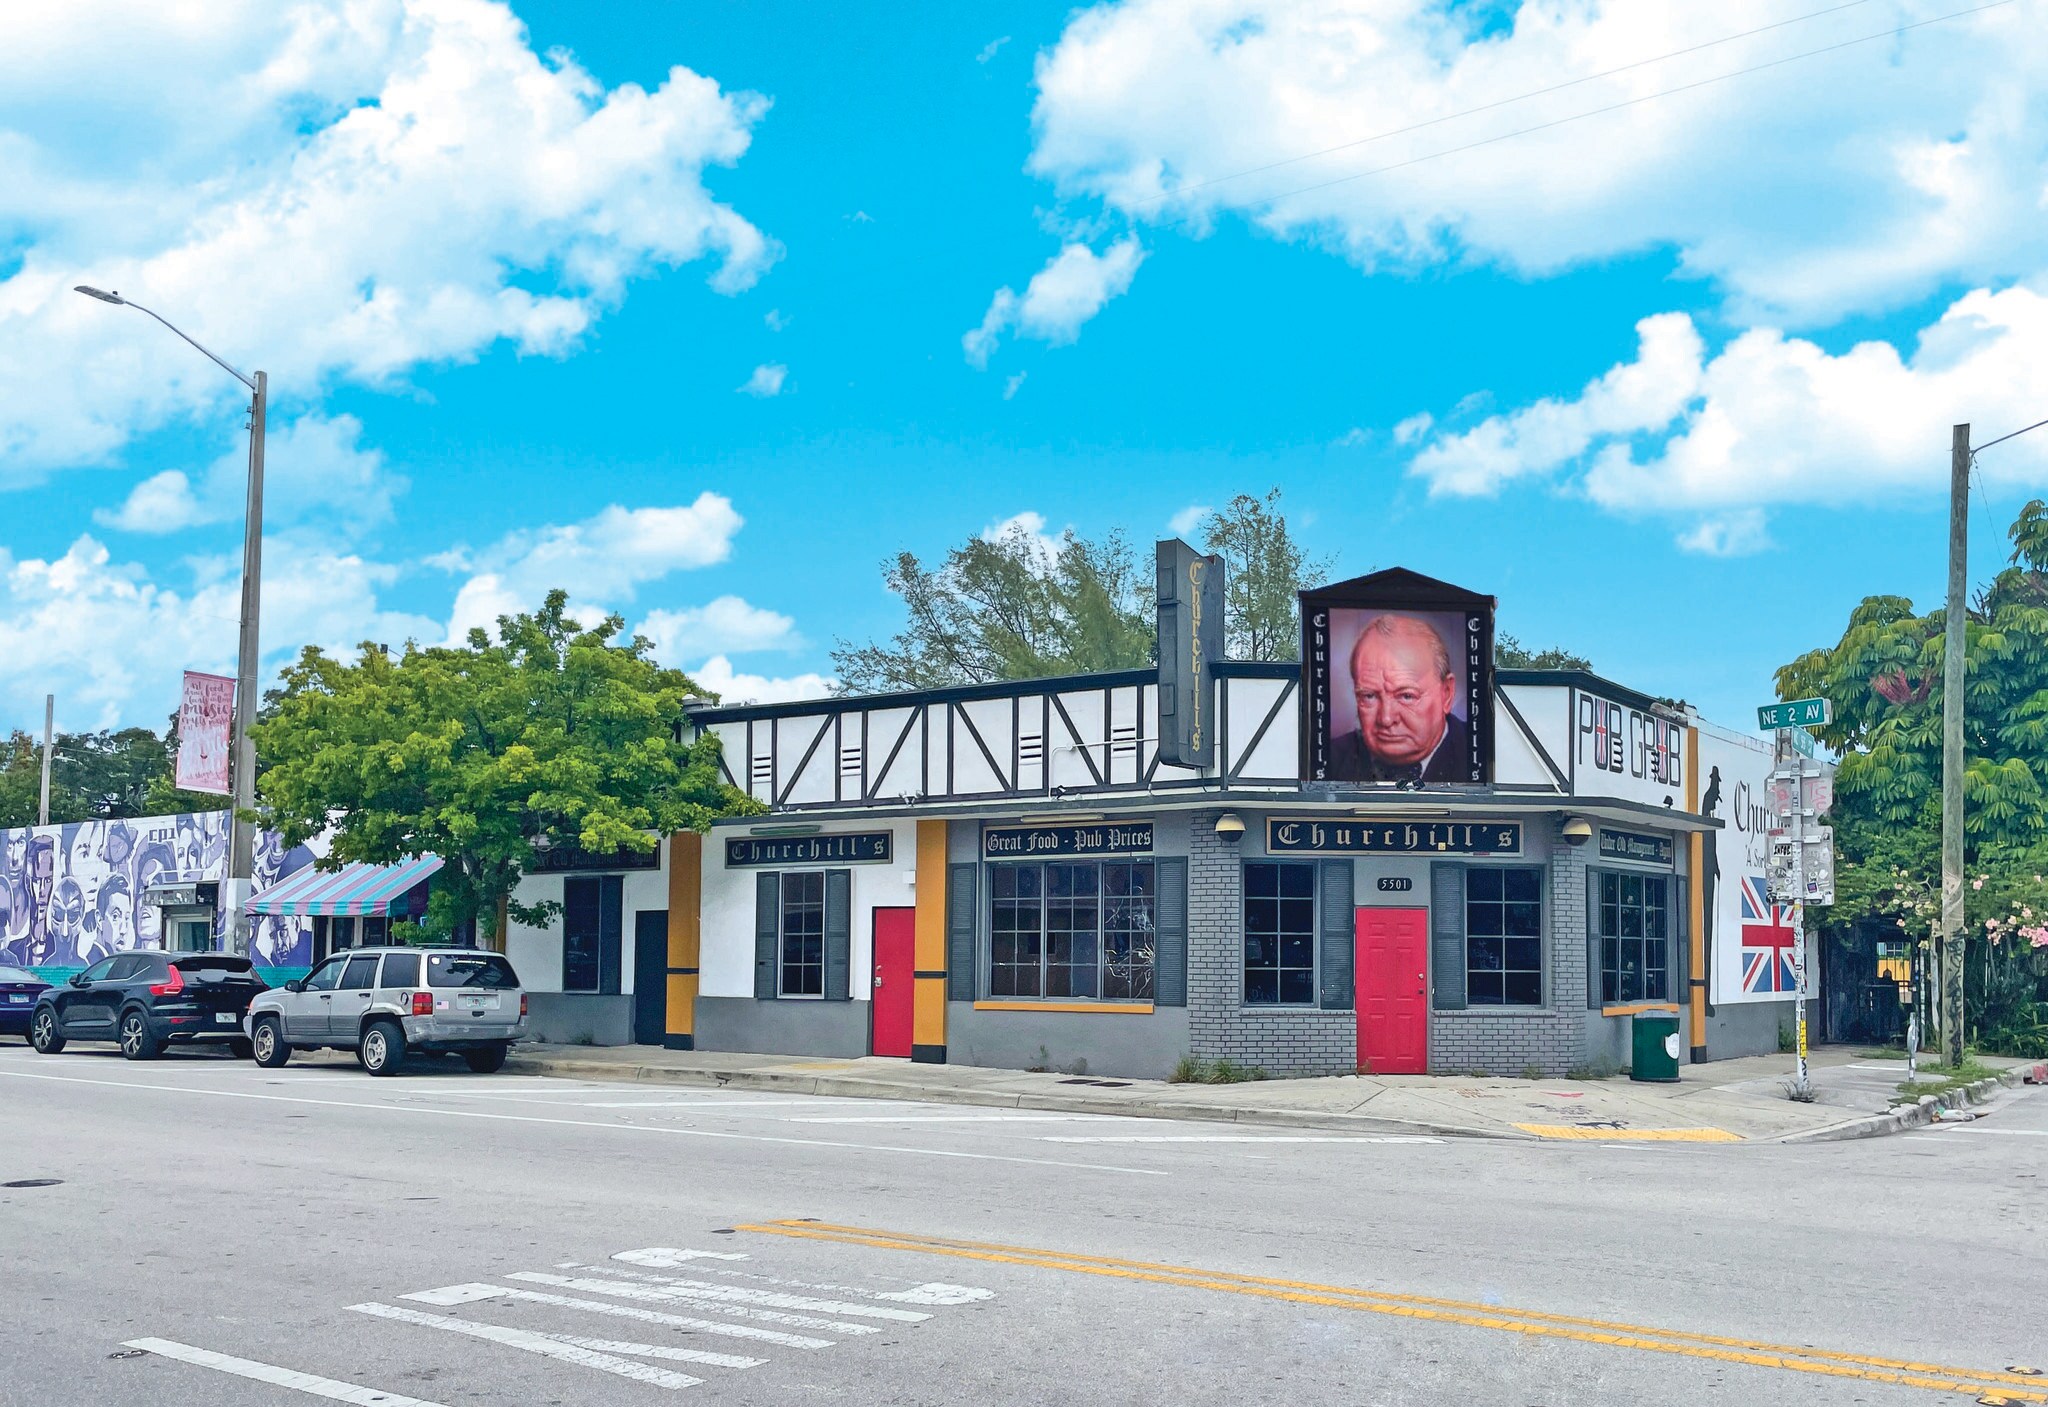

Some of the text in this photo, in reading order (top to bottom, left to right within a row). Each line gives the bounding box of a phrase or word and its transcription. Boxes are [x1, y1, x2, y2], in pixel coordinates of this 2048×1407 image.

[1189, 560, 1205, 753] Churchill's
[1313, 613, 1327, 780] Churchill's
[1467, 617, 1482, 781] Churchill's
[1762, 704, 1819, 725] NE 2 AV
[1579, 693, 1681, 787] PUB GRUB
[731, 837, 884, 862] Churchill's
[987, 832, 1022, 851] Great
[1026, 831, 1059, 852] Food
[1074, 829, 1101, 851] Pub
[1107, 826, 1152, 850] Prices
[1278, 823, 1513, 850] Churchill's
[1381, 878, 1407, 890] 5501
